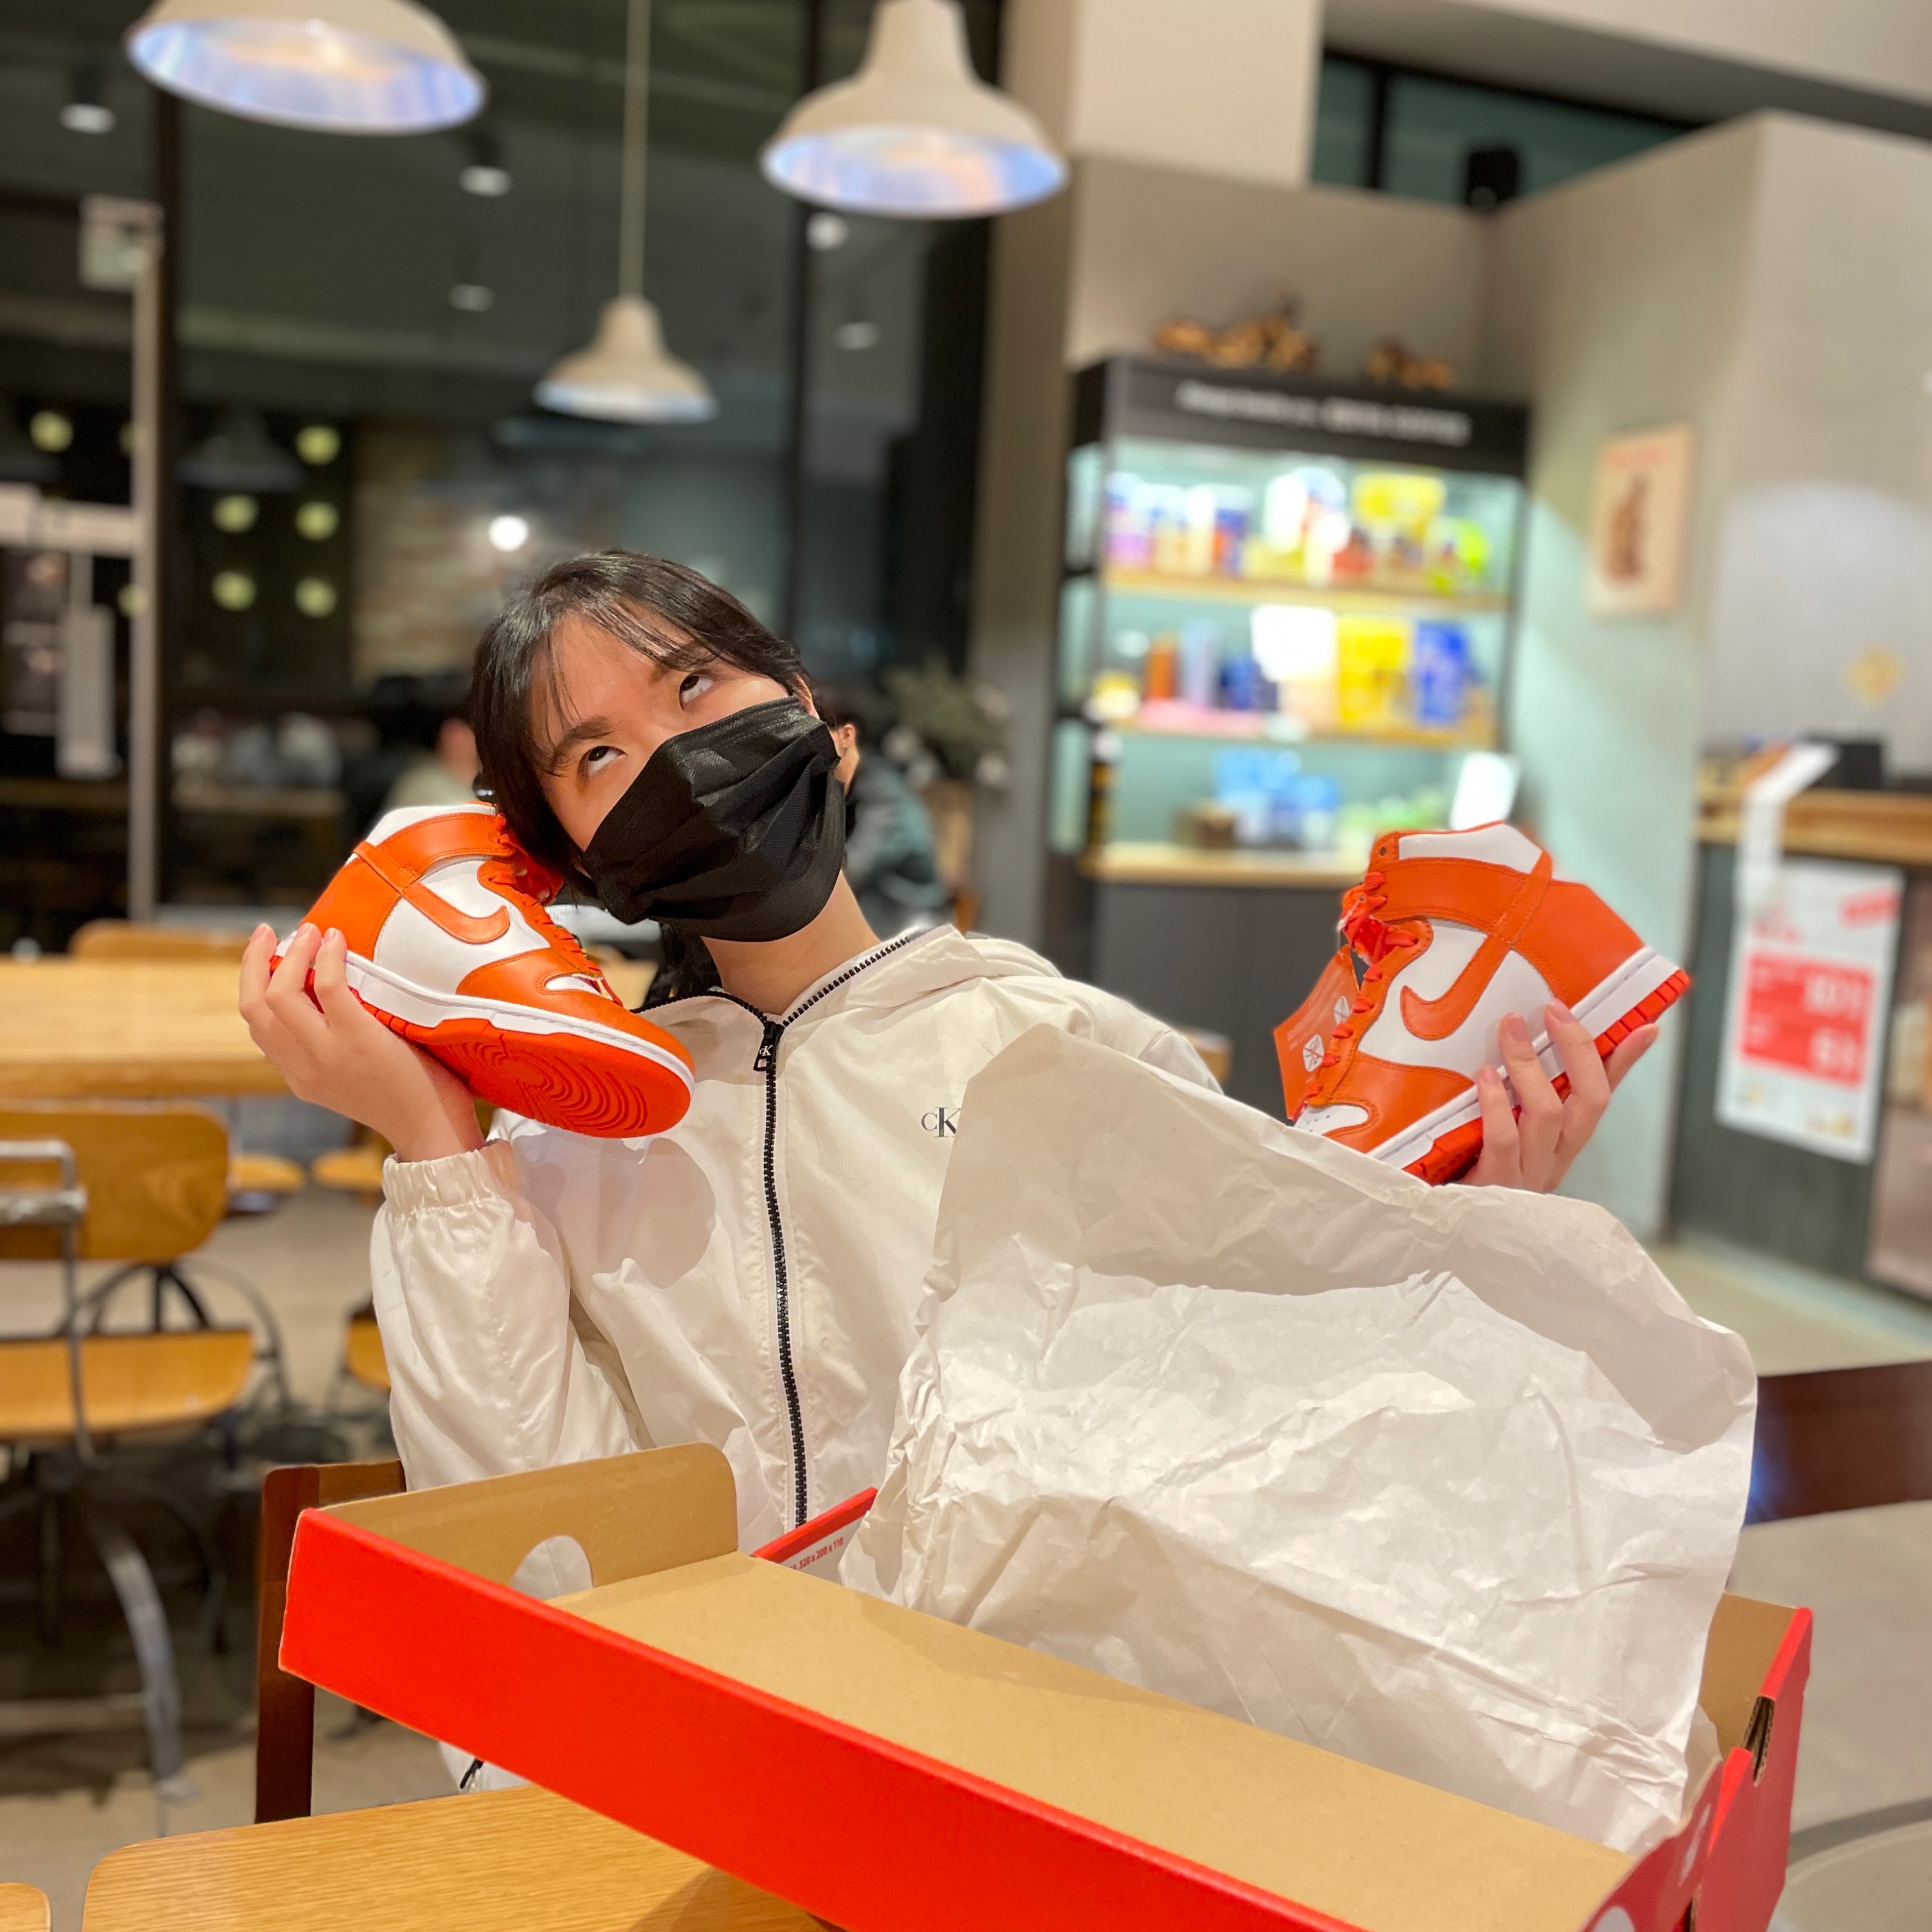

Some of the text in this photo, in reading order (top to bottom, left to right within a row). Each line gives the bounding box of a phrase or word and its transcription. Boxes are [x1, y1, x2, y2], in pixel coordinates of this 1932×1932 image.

[921, 1107, 961, 1138] CK
[799, 1556, 810, 1570] 320
[816, 1546, 827, 1560] 200
[833, 1537, 843, 1549] 110
